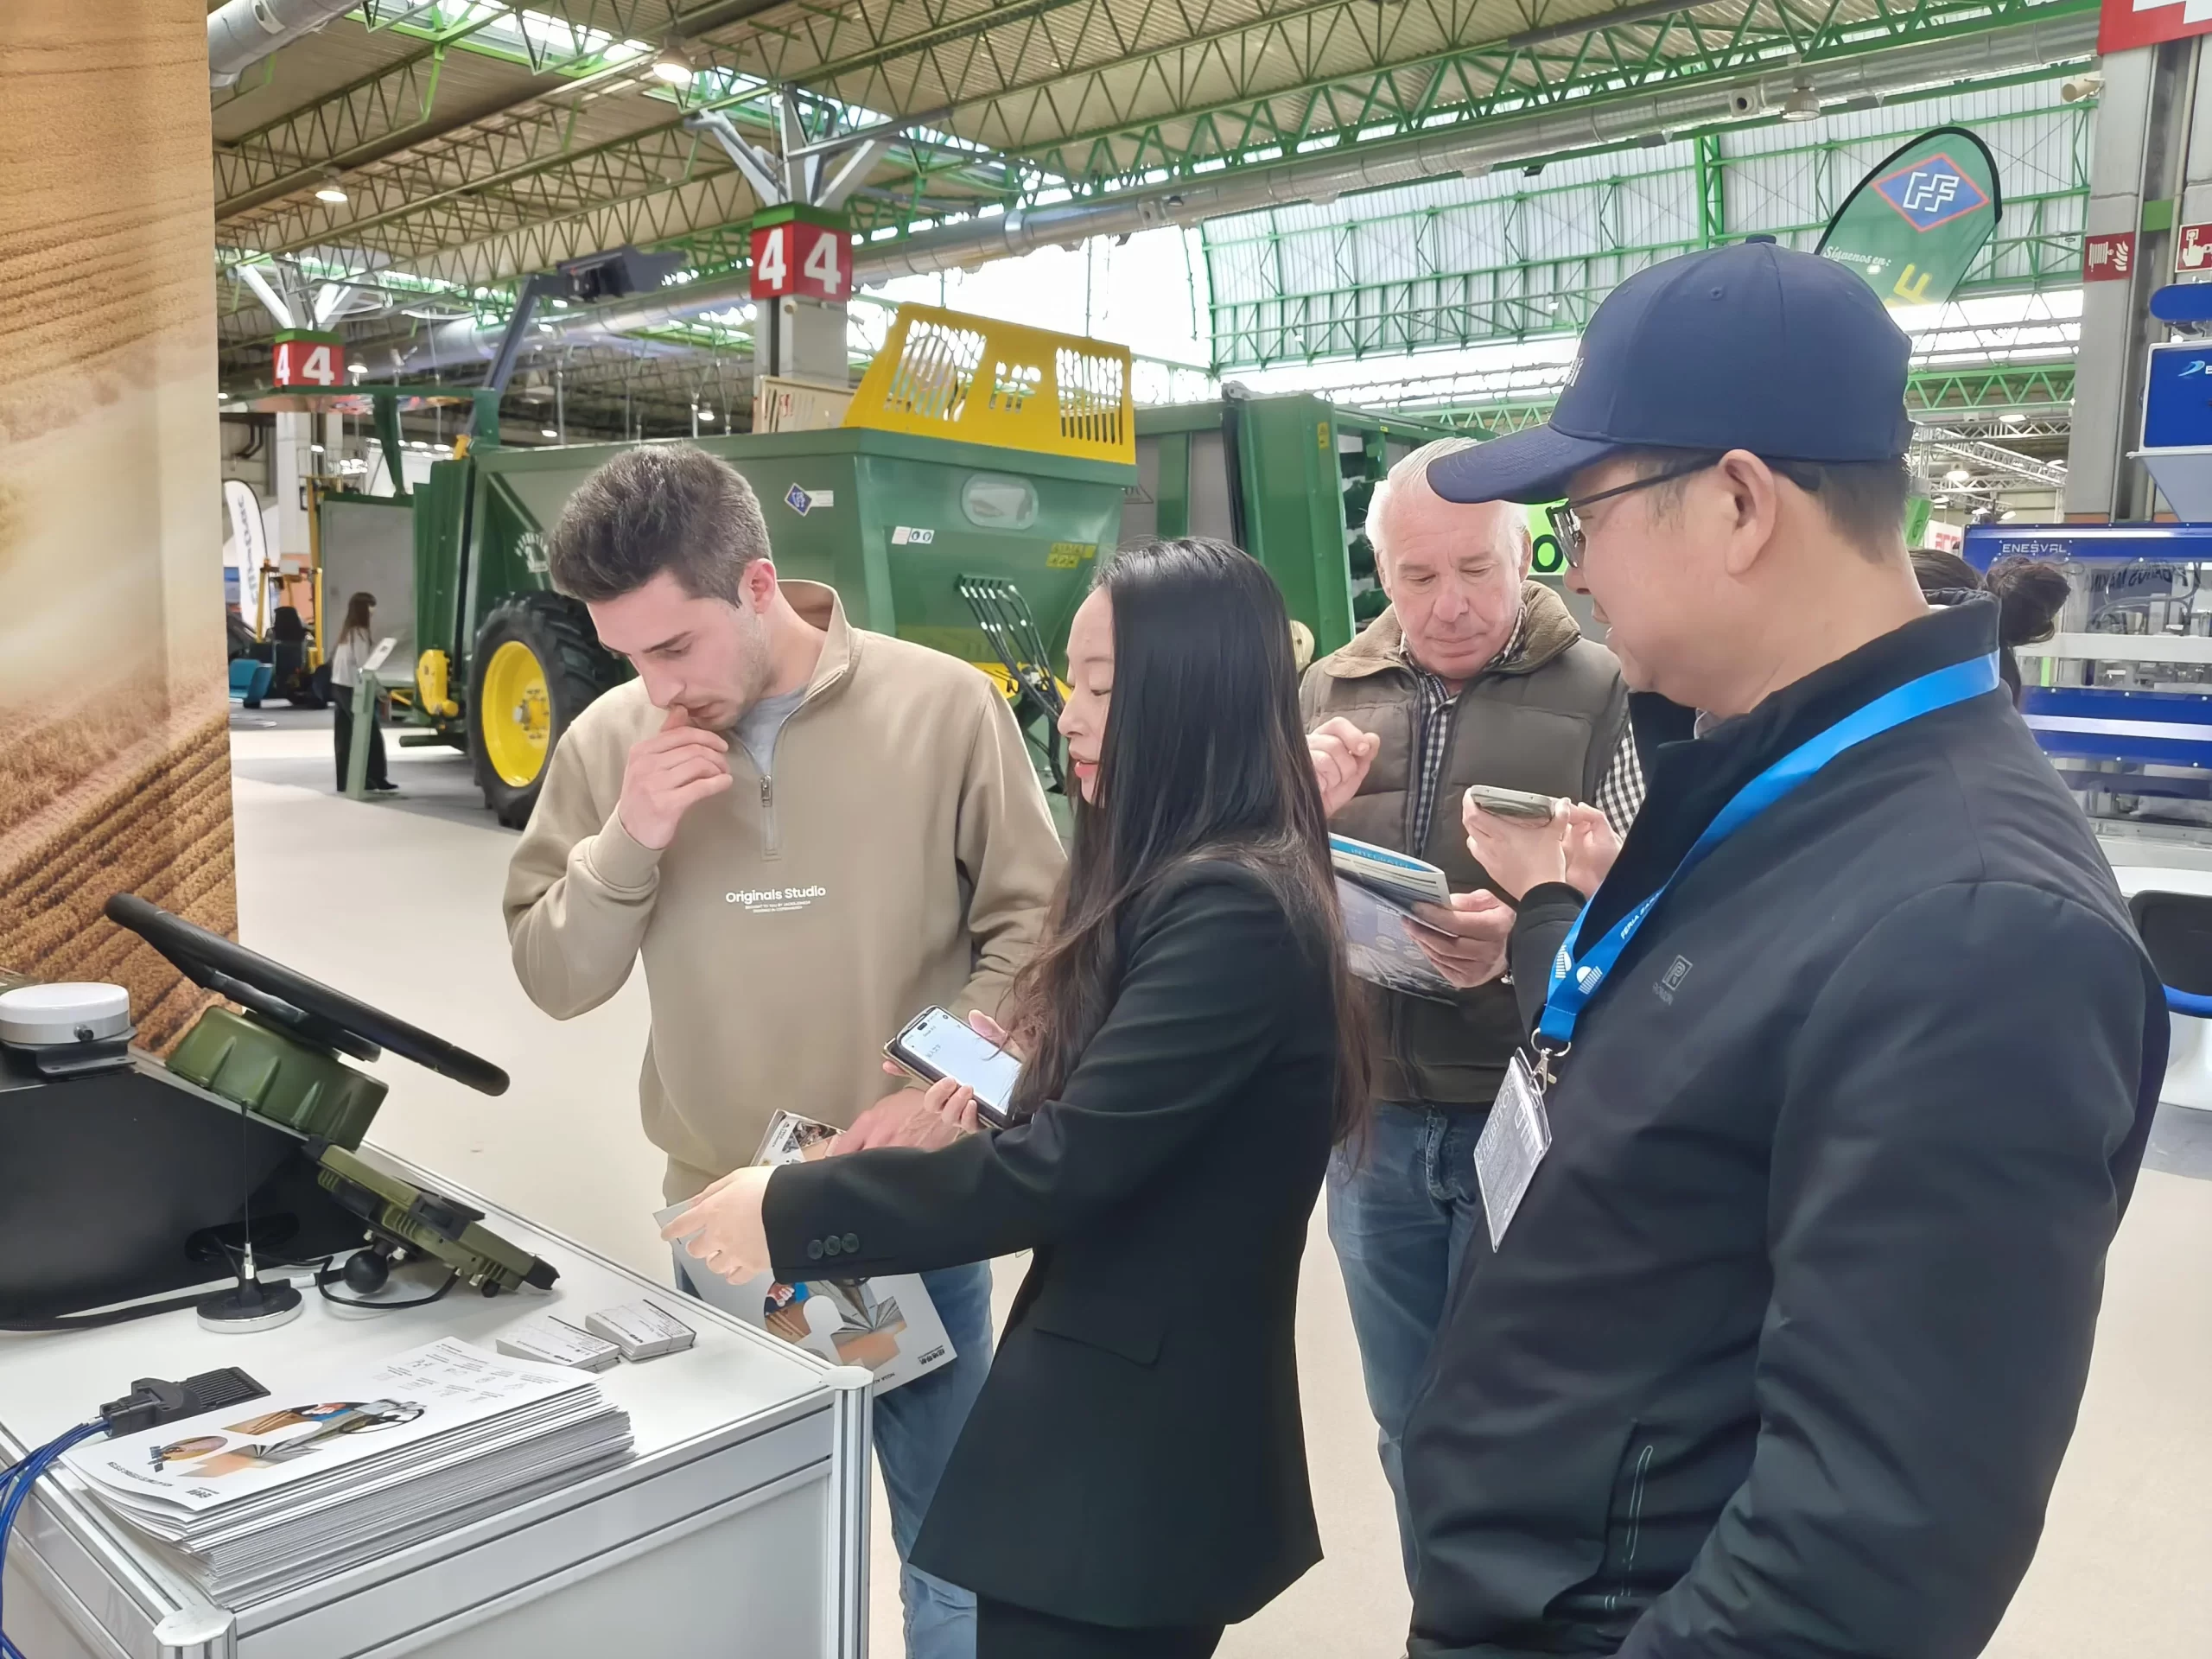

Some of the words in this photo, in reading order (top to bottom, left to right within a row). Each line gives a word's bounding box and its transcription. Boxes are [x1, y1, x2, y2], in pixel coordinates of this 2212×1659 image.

[758, 227, 787, 290] 4
[804, 232, 842, 295] 4
[276, 344, 290, 385] 4
[302, 346, 335, 385] 4
[725, 888, 783, 906] Originals
[784, 885, 827, 899] Studio
[1620, 914, 1639, 940] FERIA
